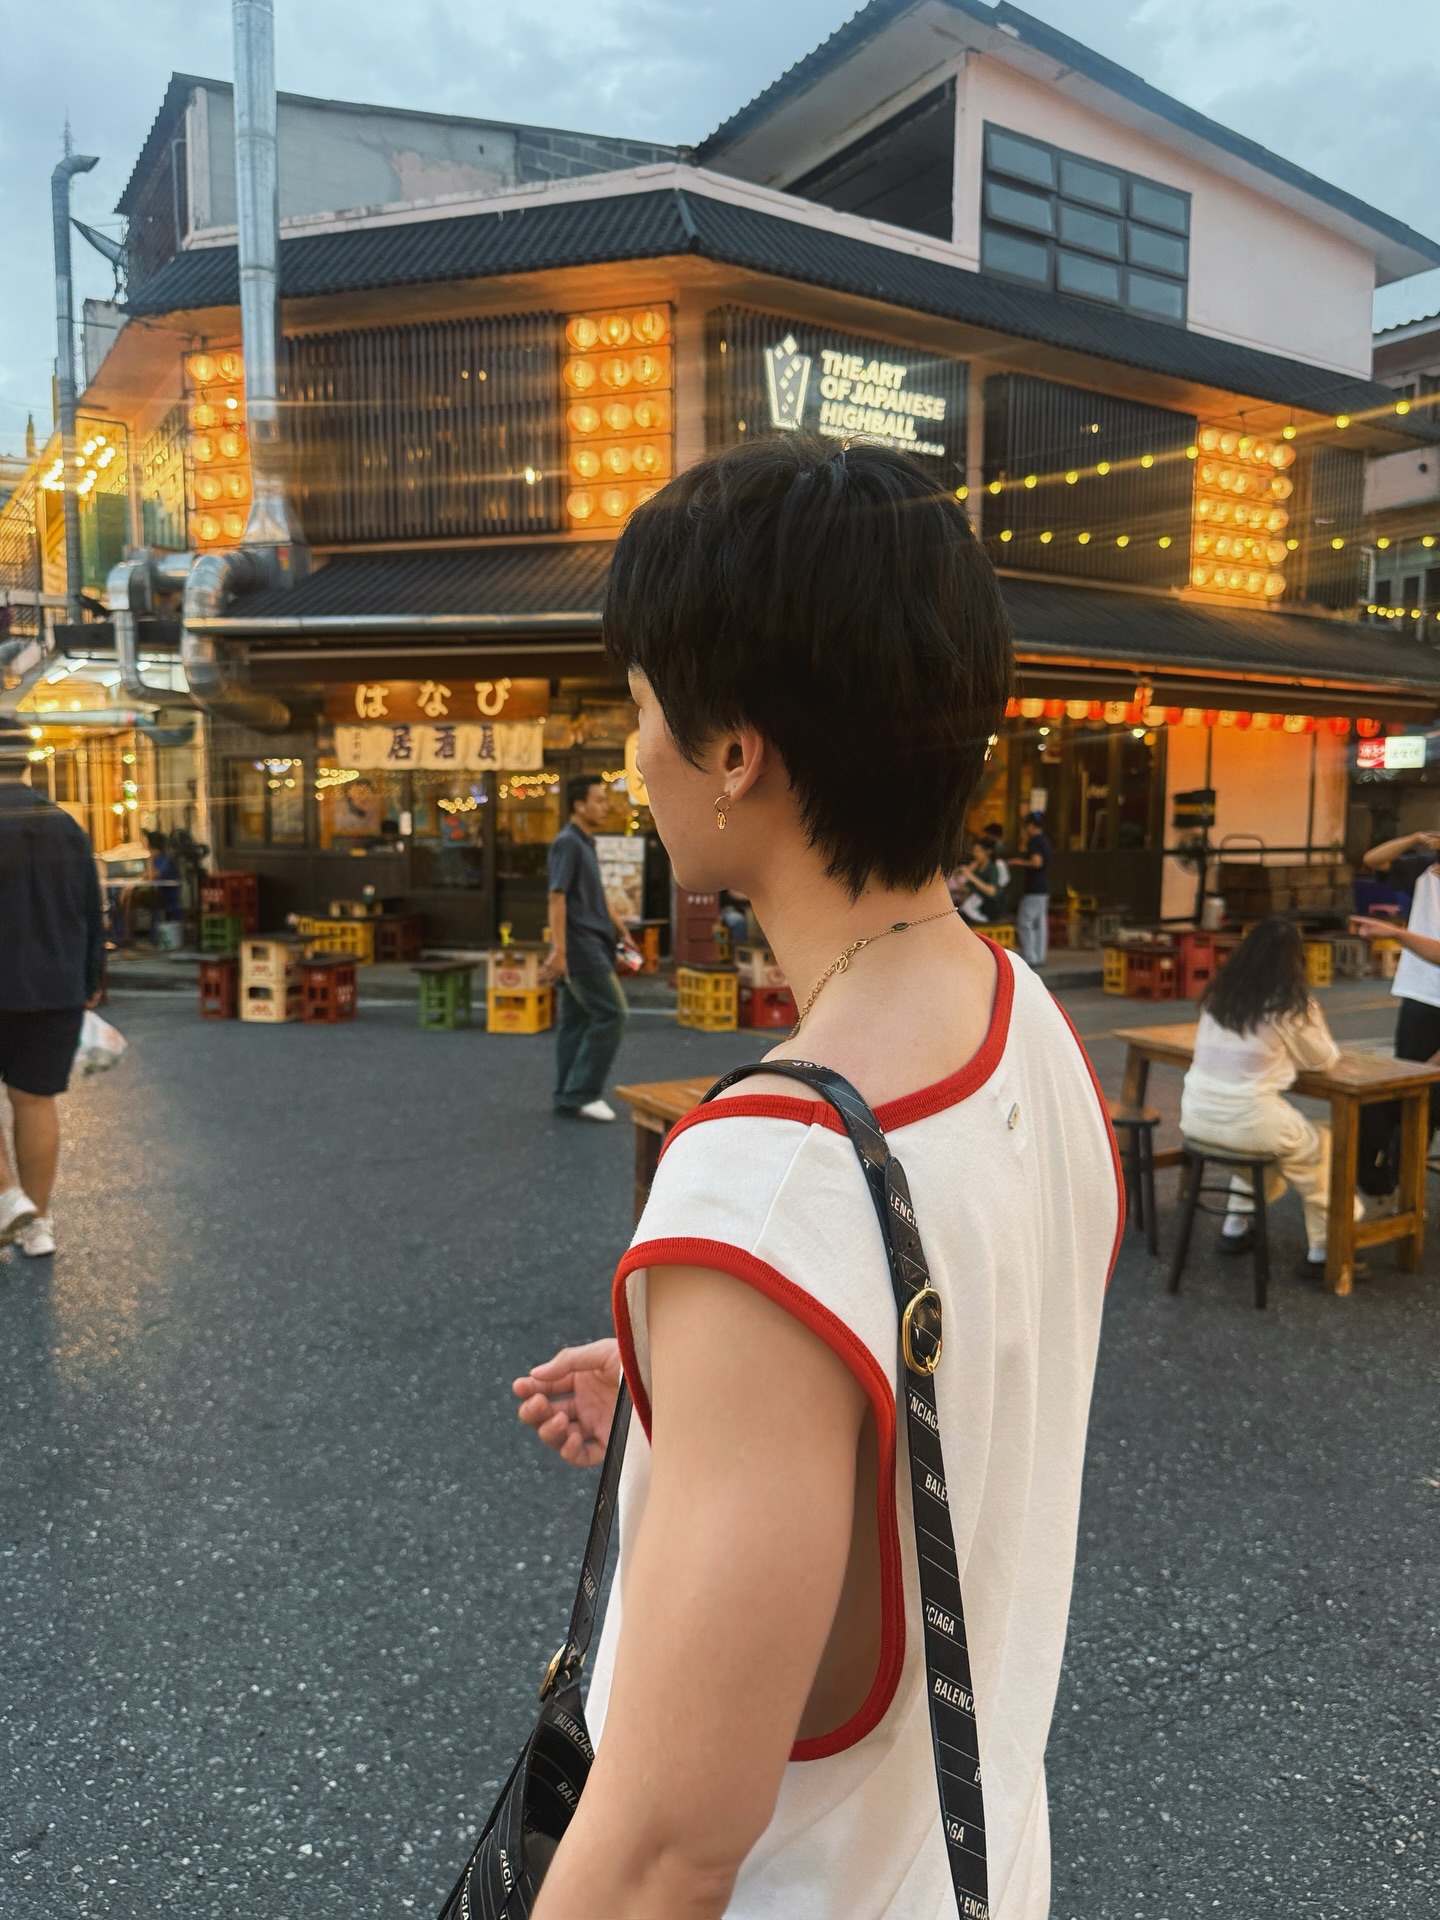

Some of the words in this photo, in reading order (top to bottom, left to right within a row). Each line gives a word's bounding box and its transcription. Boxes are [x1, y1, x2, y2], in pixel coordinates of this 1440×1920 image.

[821, 350, 864, 381] THE
[865, 360, 907, 390] ART
[820, 375, 852, 401] OF
[852, 381, 946, 421] JAPANESE
[355, 677, 512, 718] はなび
[925, 1604, 955, 1636] CIAGA
